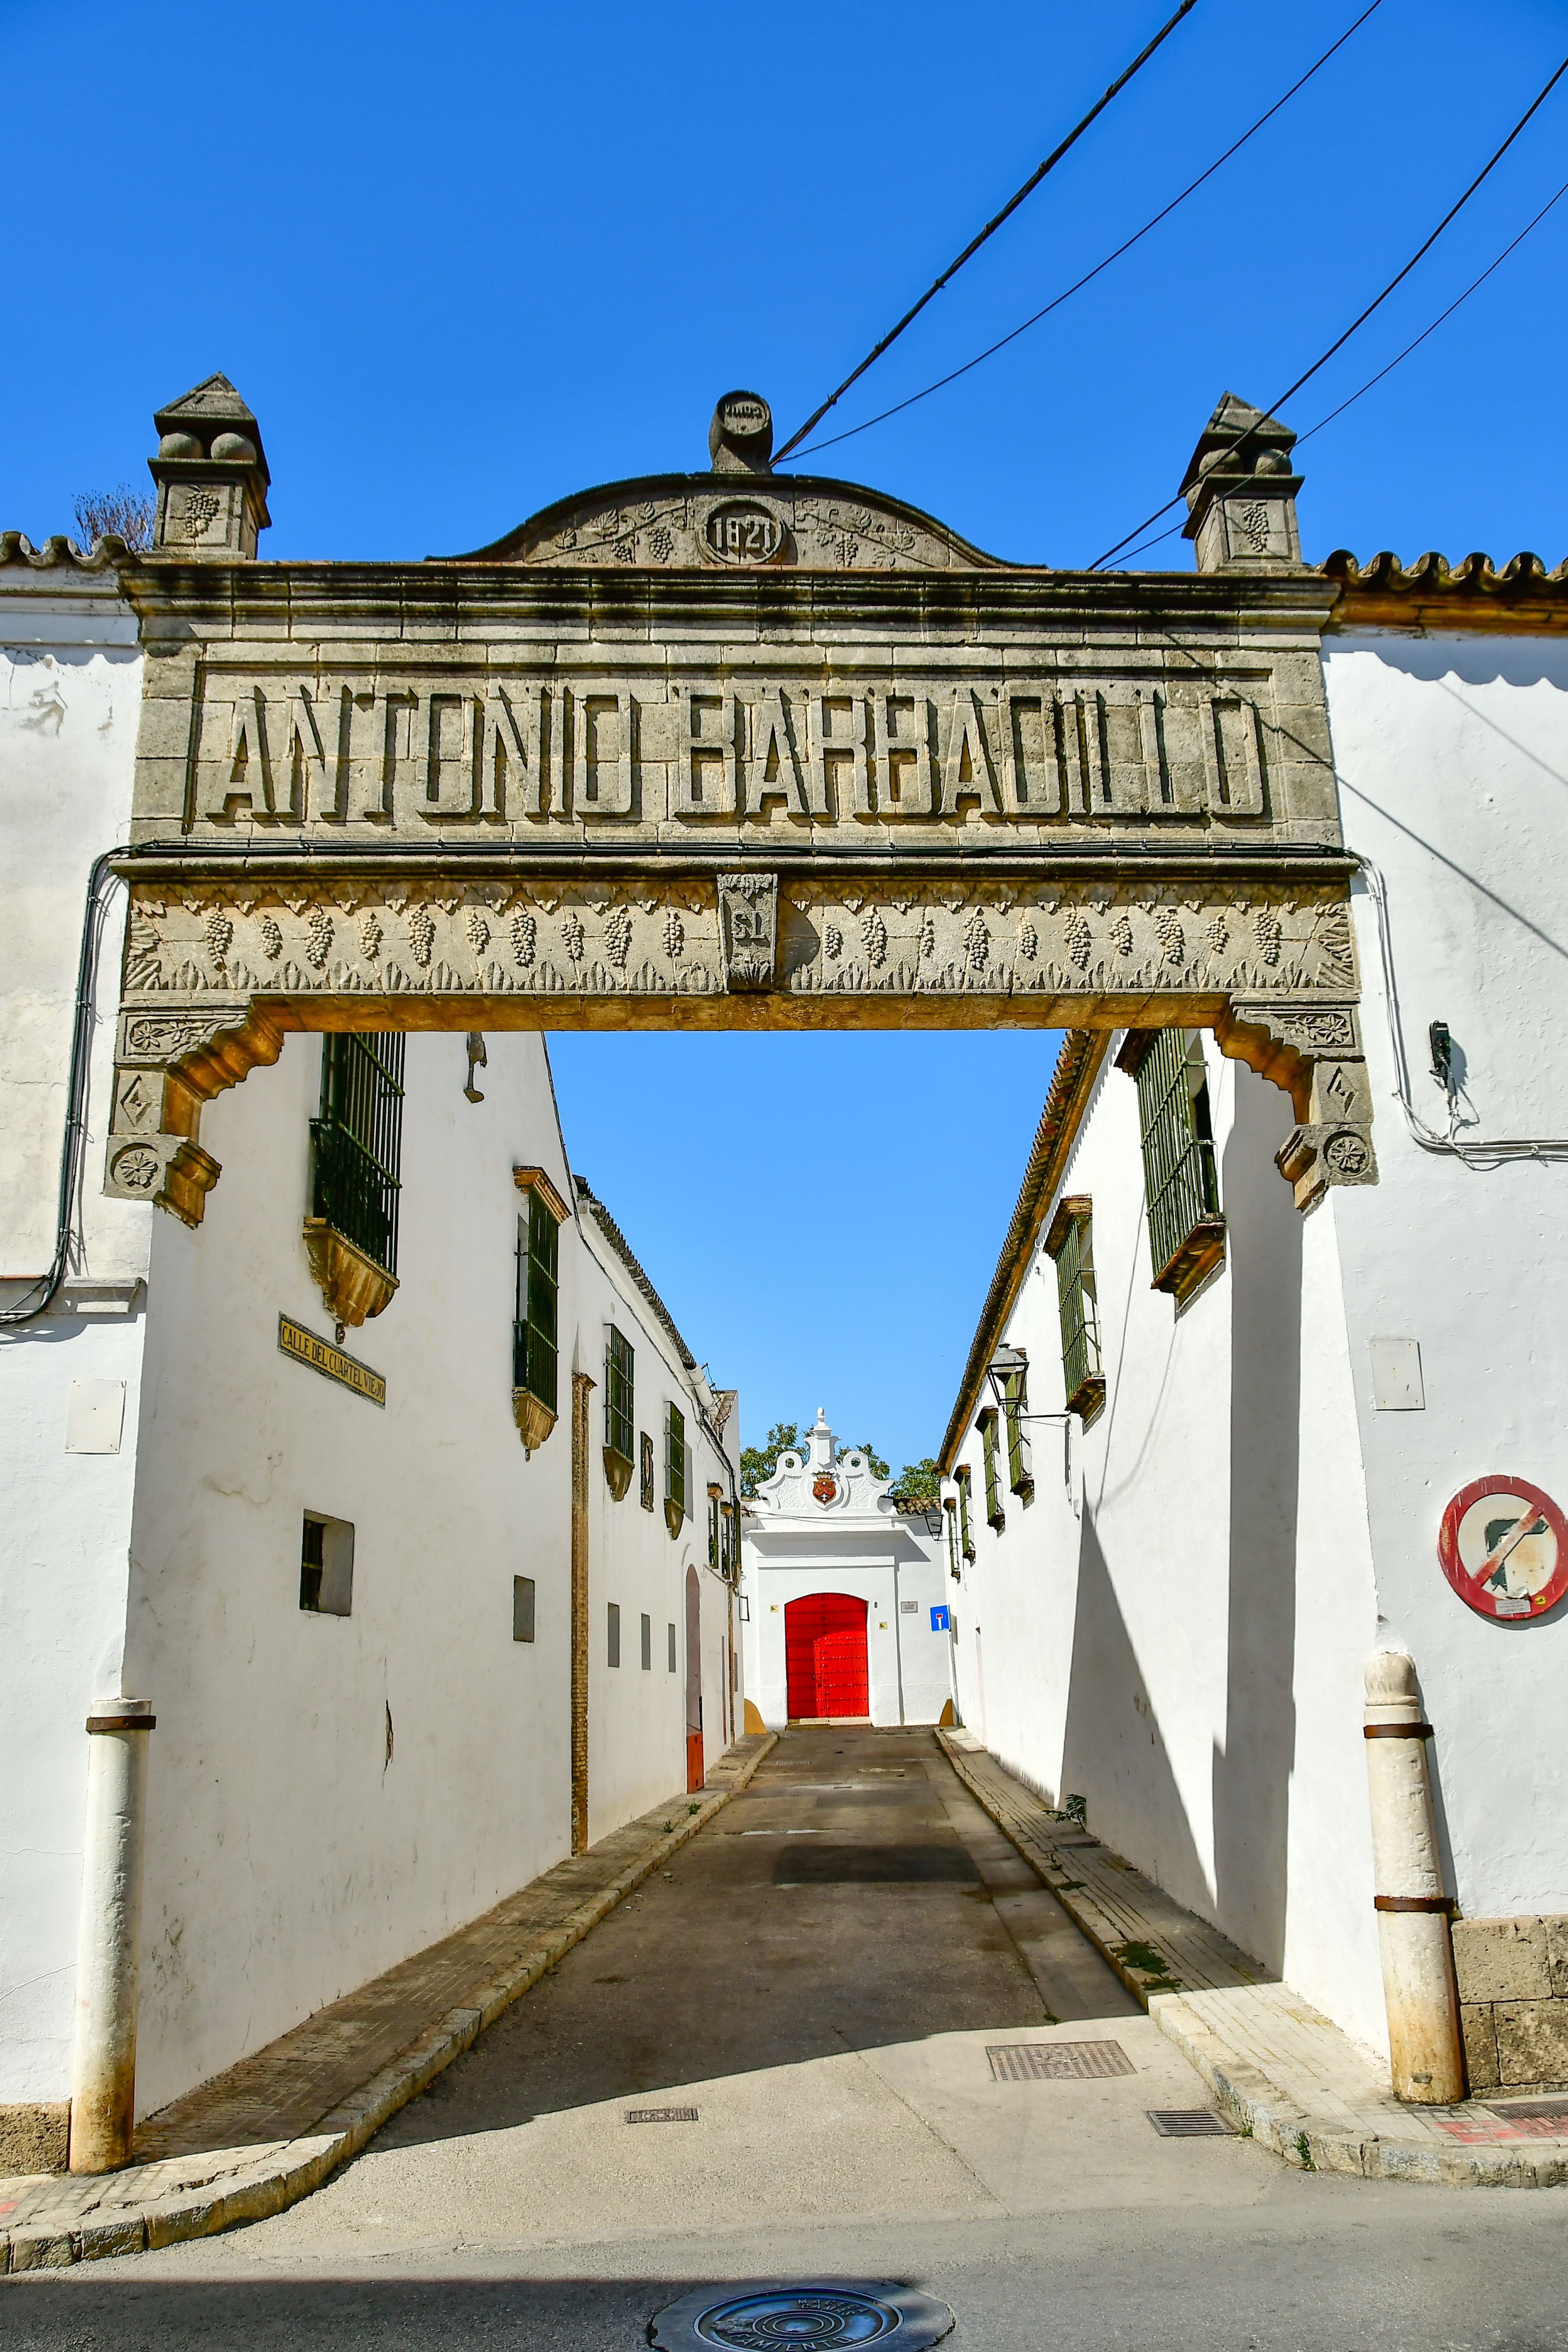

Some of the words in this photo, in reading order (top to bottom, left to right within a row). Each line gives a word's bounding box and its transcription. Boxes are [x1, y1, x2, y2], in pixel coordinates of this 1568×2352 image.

[725, 403, 760, 415] VINOS
[713, 515, 771, 550] 1821
[205, 683, 643, 819] ANTONIO
[675, 684, 1268, 819] BARBADILLO
[282, 1325, 310, 1357] CALLE
[312, 1340, 327, 1367] DEL
[329, 1353, 362, 1387] CUARTEL
[364, 1373, 384, 1399] VIEJO
